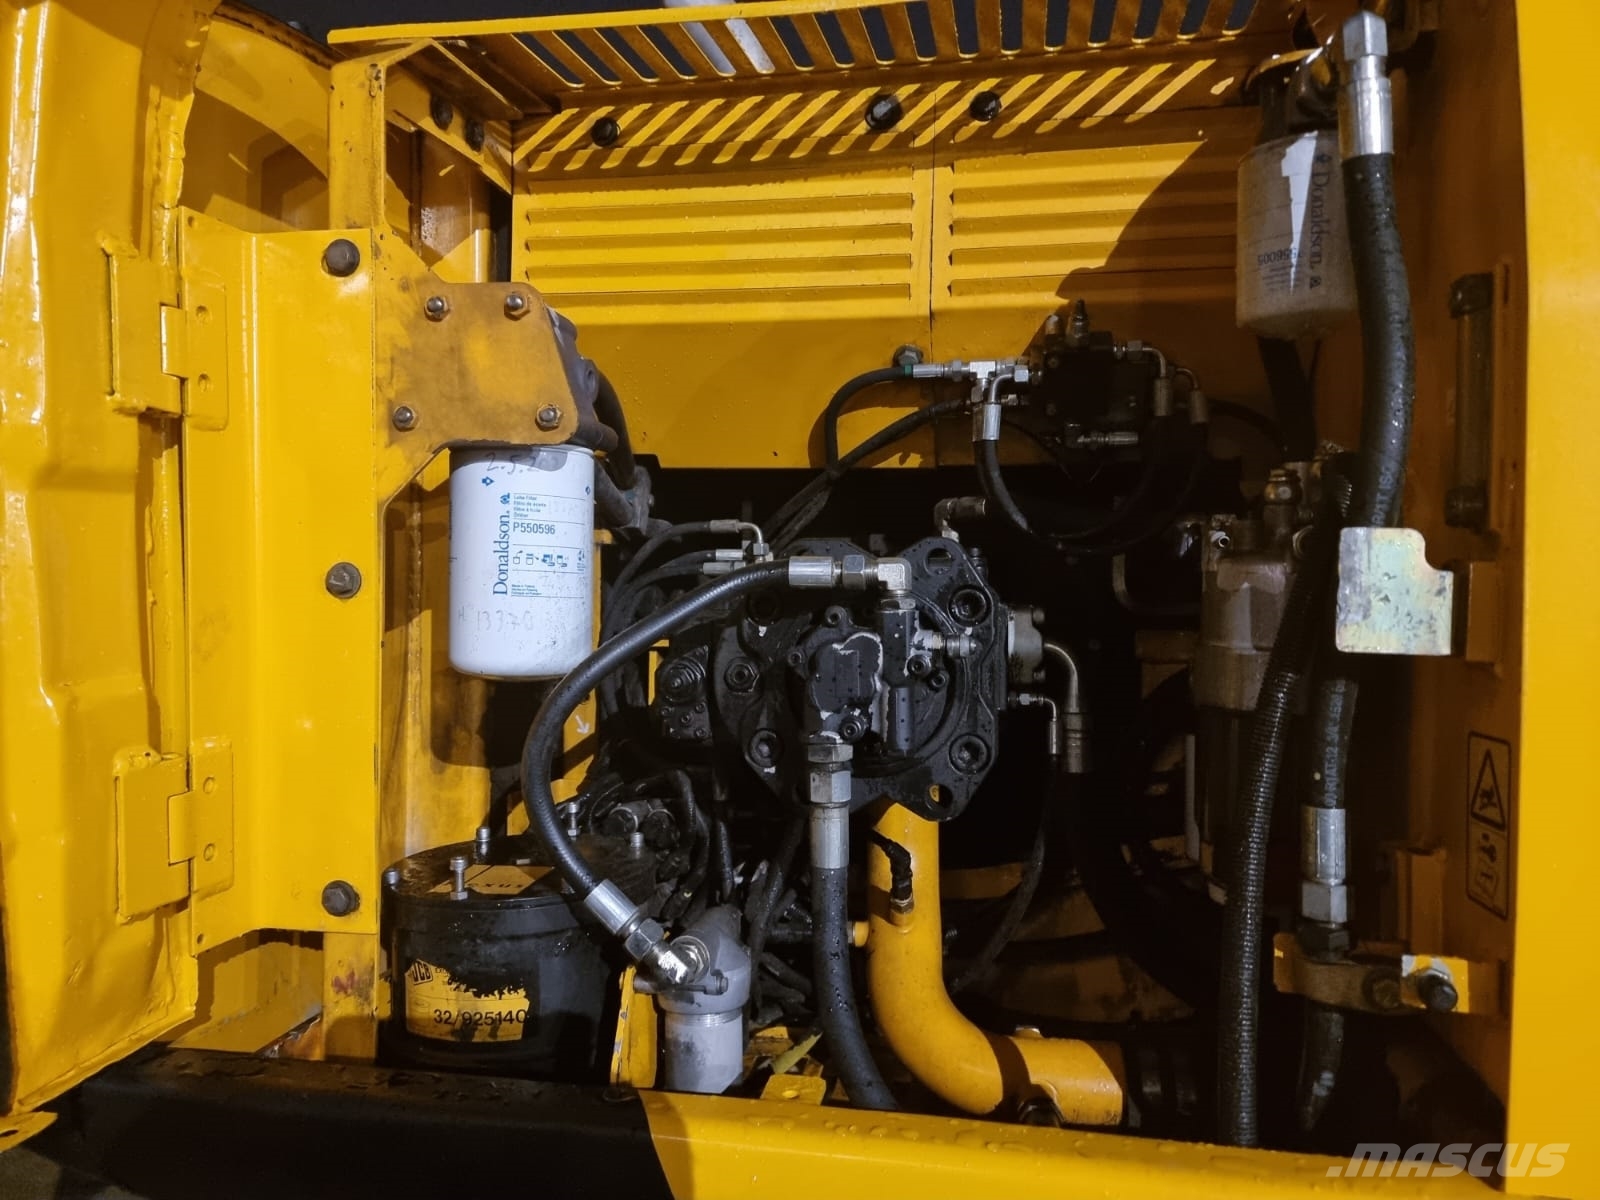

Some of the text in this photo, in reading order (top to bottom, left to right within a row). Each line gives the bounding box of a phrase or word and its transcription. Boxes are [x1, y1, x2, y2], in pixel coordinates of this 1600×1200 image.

[512, 521, 556, 535] P550596
[411, 961, 431, 982] JCB
[433, 1008, 528, 1026] 32/925140
